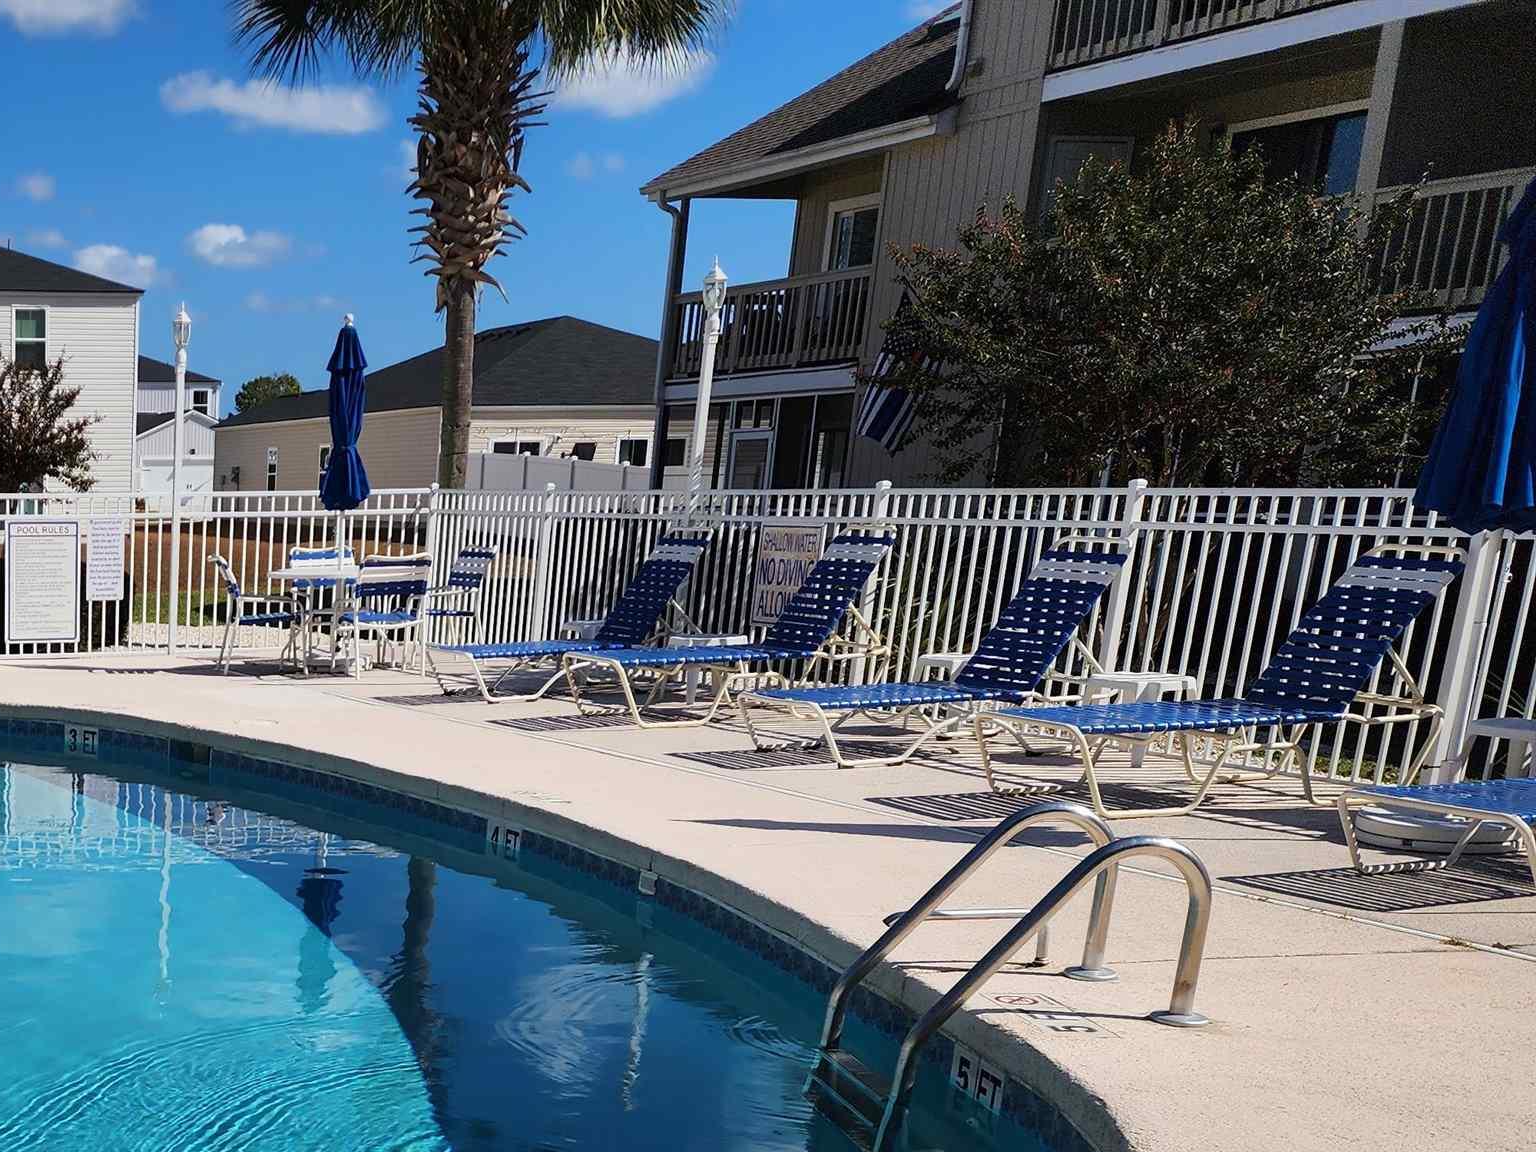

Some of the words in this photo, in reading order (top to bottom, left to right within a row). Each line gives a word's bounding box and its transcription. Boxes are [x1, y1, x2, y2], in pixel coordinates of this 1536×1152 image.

[16, 526, 40, 534] POOL
[41, 525, 70, 534] RULES
[794, 533, 818, 553] WATER
[758, 558, 776, 586] NO
[756, 590, 792, 618] ALLO
[69, 728, 77, 752] 3
[954, 1055, 971, 1090] 5
[975, 1068, 1002, 1109] FT
